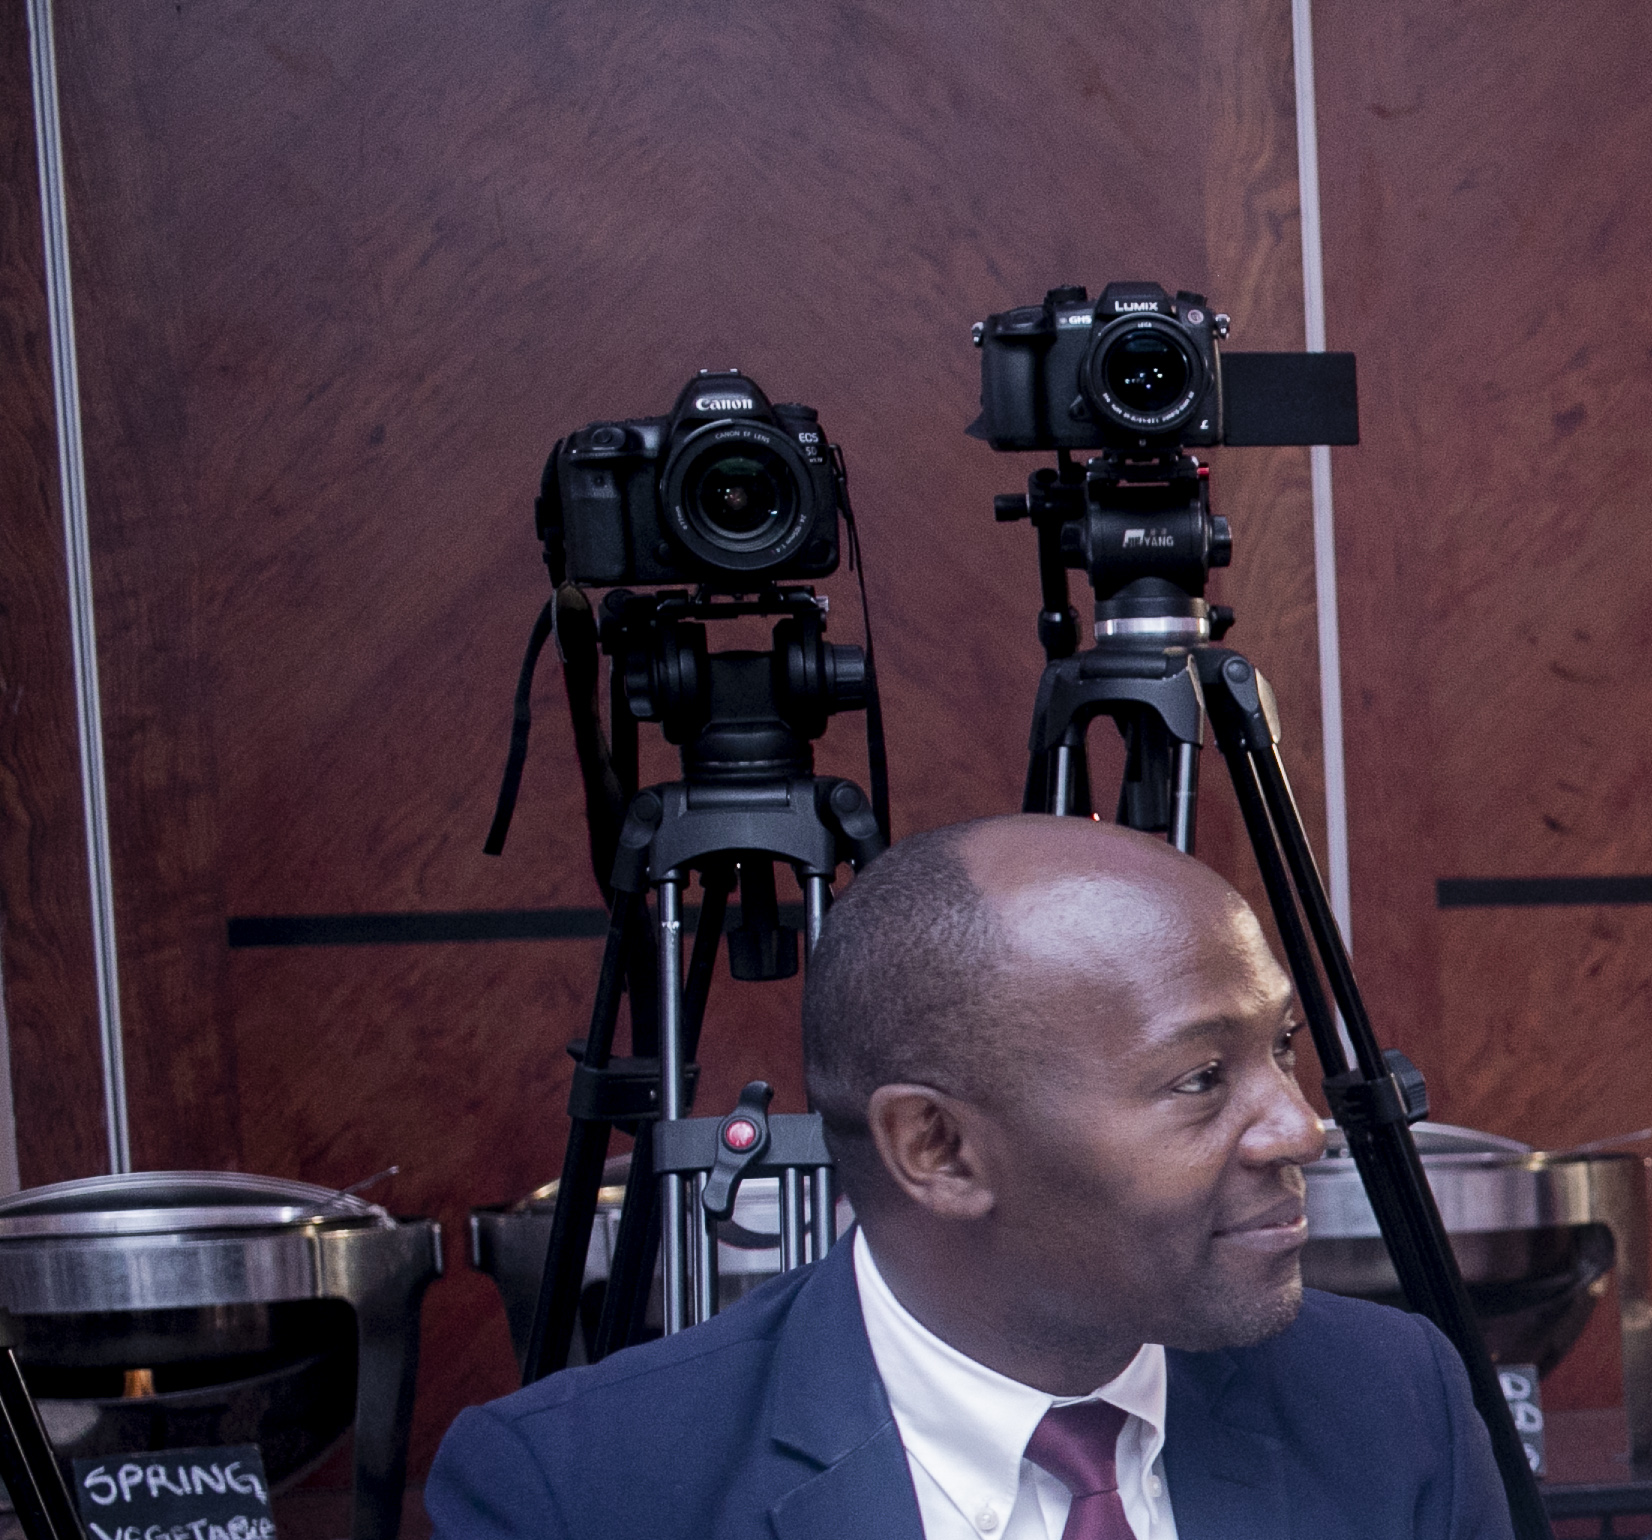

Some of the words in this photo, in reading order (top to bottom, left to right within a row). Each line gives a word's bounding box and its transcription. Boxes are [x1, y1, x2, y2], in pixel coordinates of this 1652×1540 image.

[1114, 300, 1158, 313] LUMIX
[1068, 314, 1092, 325] GH5
[695, 398, 753, 411] Canon
[715, 430, 741, 440] CANON
[753, 433, 770, 443] LENS
[798, 432, 819, 443] EOS
[805, 446, 817, 456] 5D
[84, 1461, 267, 1504] SPRING
